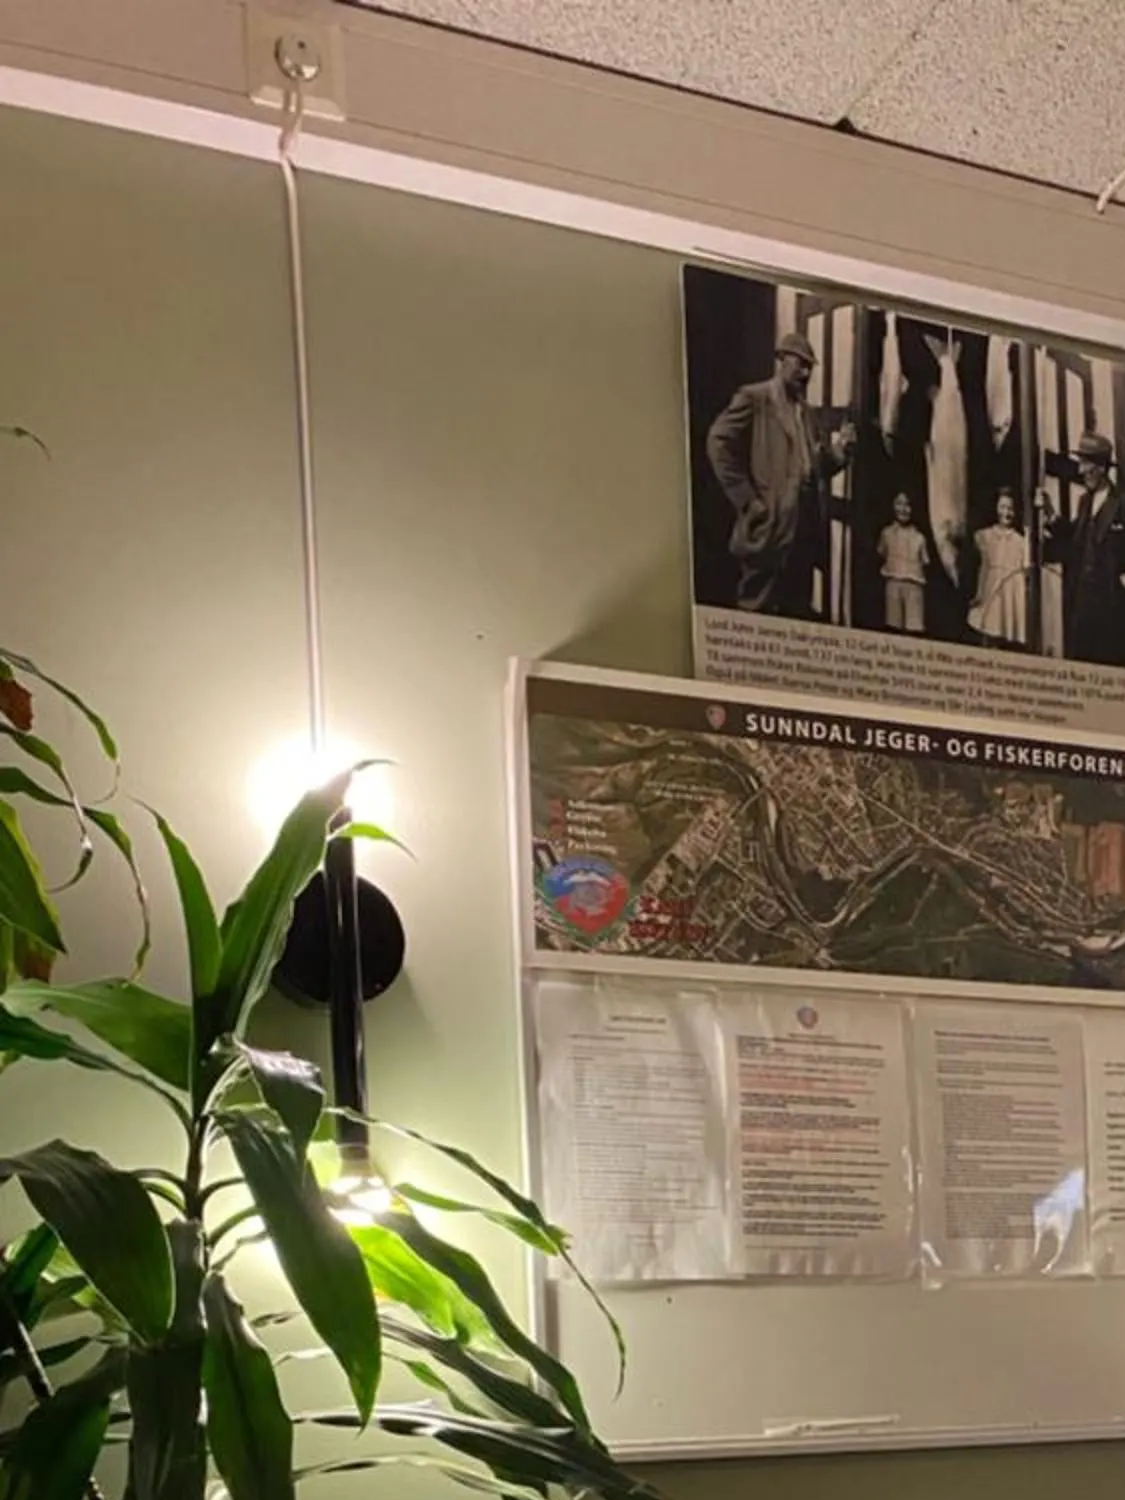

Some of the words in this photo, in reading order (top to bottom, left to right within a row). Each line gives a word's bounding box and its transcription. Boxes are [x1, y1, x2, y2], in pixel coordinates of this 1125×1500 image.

[745, 713, 857, 745] SUNNDAL
[863, 727, 940, 753] JEGER-
[946, 738, 978, 759] OG
